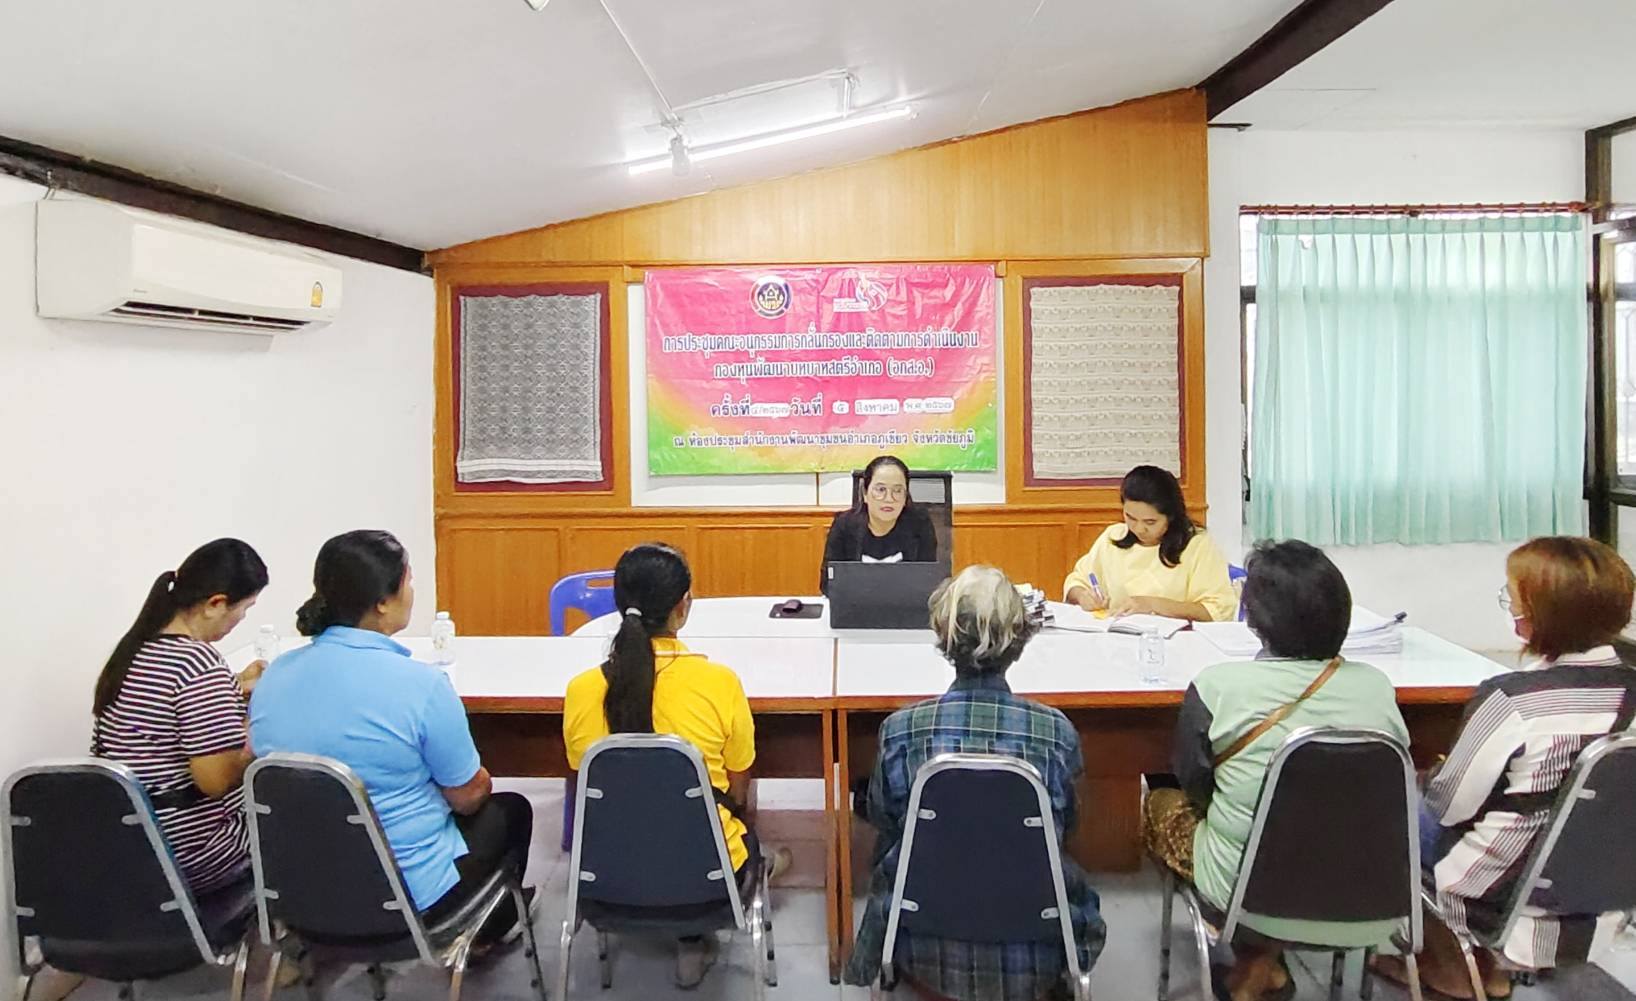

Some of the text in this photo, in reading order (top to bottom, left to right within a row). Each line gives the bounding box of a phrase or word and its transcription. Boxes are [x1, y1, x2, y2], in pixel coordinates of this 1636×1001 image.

[664, 324, 977, 358] การประชุมคณะอนุกรรมการกลั่นกรองและติดตามการดำเนินงาน
[715, 357, 882, 382] กองทุนพัฒนาบทบาทสตรีอำเภอ
[711, 394, 750, 416] ครั้งที่
[791, 393, 822, 415] วันที่
[674, 436, 685, 447] ณ
[913, 430, 974, 449] จังหวัดชัยภูมิ
